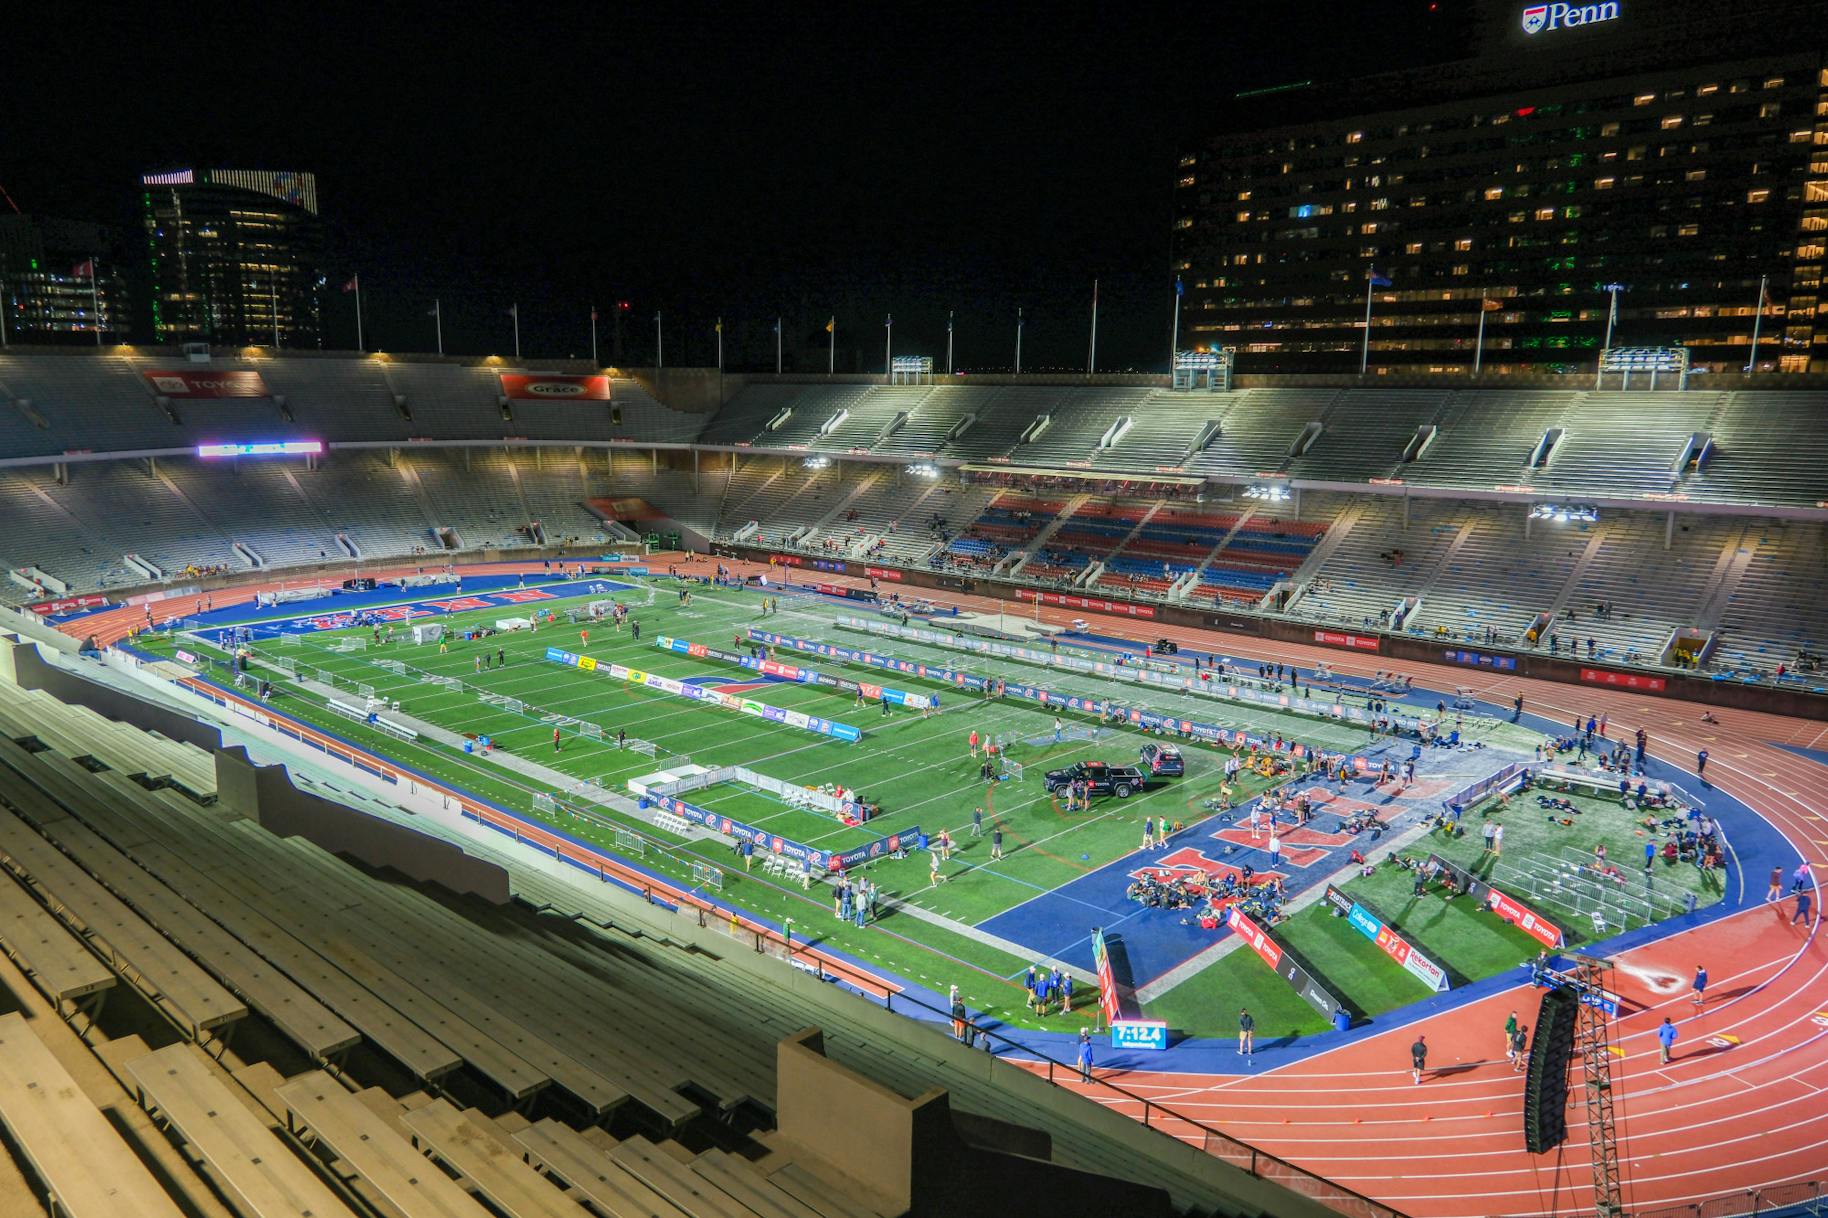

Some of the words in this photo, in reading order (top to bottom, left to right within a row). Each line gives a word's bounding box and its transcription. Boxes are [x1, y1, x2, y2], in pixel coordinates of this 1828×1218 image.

[1547, 1, 1619, 31] Penn
[533, 385, 579, 393] Grace
[684, 807, 703, 820] TOYOTA
[731, 825, 752, 838] TOYOTA
[899, 831, 919, 844] TOYOTA
[783, 844, 806, 858] TOYOTA
[842, 850, 866, 863] TOYOTA
[1500, 901, 1521, 920] TOYOTA
[1534, 922, 1556, 942] TOYOTA
[1238, 920, 1254, 938] TOYOTA
[1262, 942, 1278, 962] TOYOTA
[1410, 951, 1440, 978] Rekortan
[1117, 1026, 1161, 1041] 7:12.4
